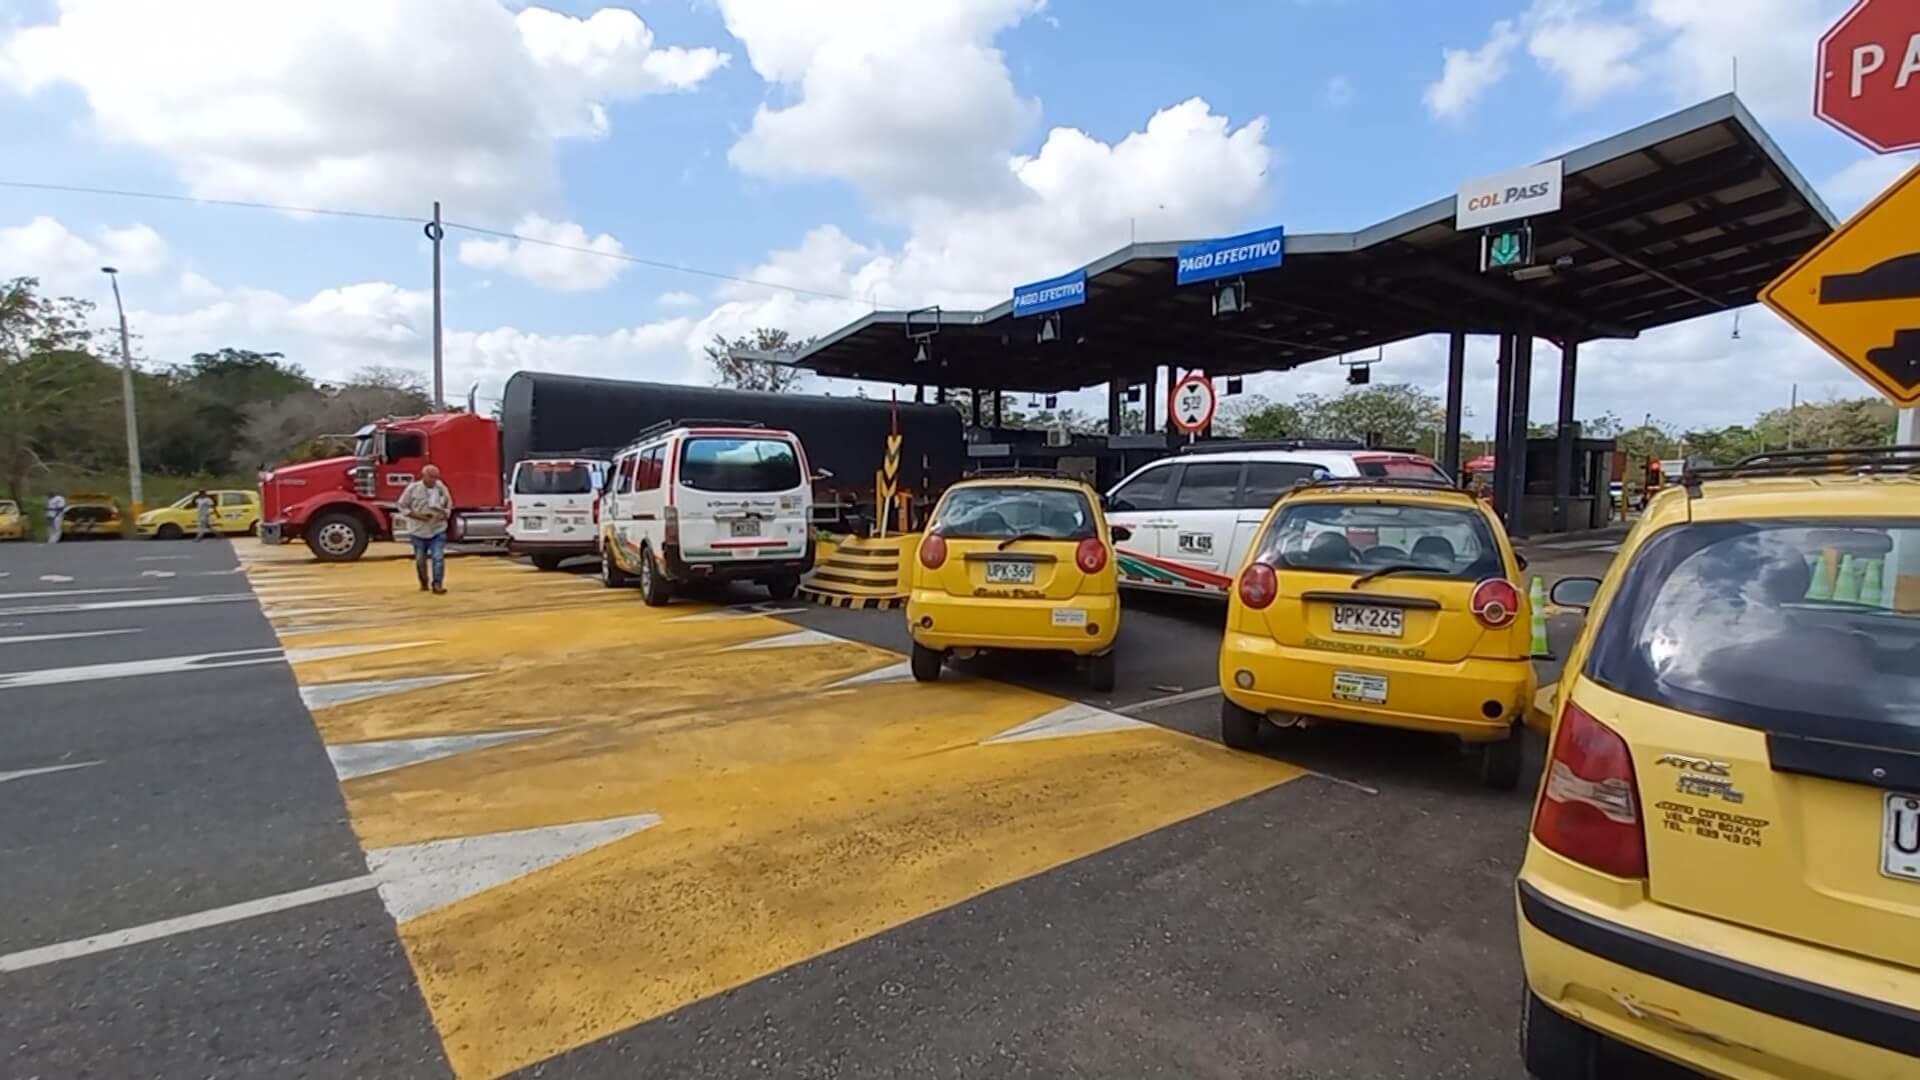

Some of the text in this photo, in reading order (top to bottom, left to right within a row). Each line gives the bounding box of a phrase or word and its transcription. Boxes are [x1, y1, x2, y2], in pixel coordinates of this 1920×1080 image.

[1468, 182, 1550, 211] COL PASS
[1178, 239, 1281, 272] PAGO EFECTIVO
[1014, 281, 1084, 308] PAGO EFECTIVO
